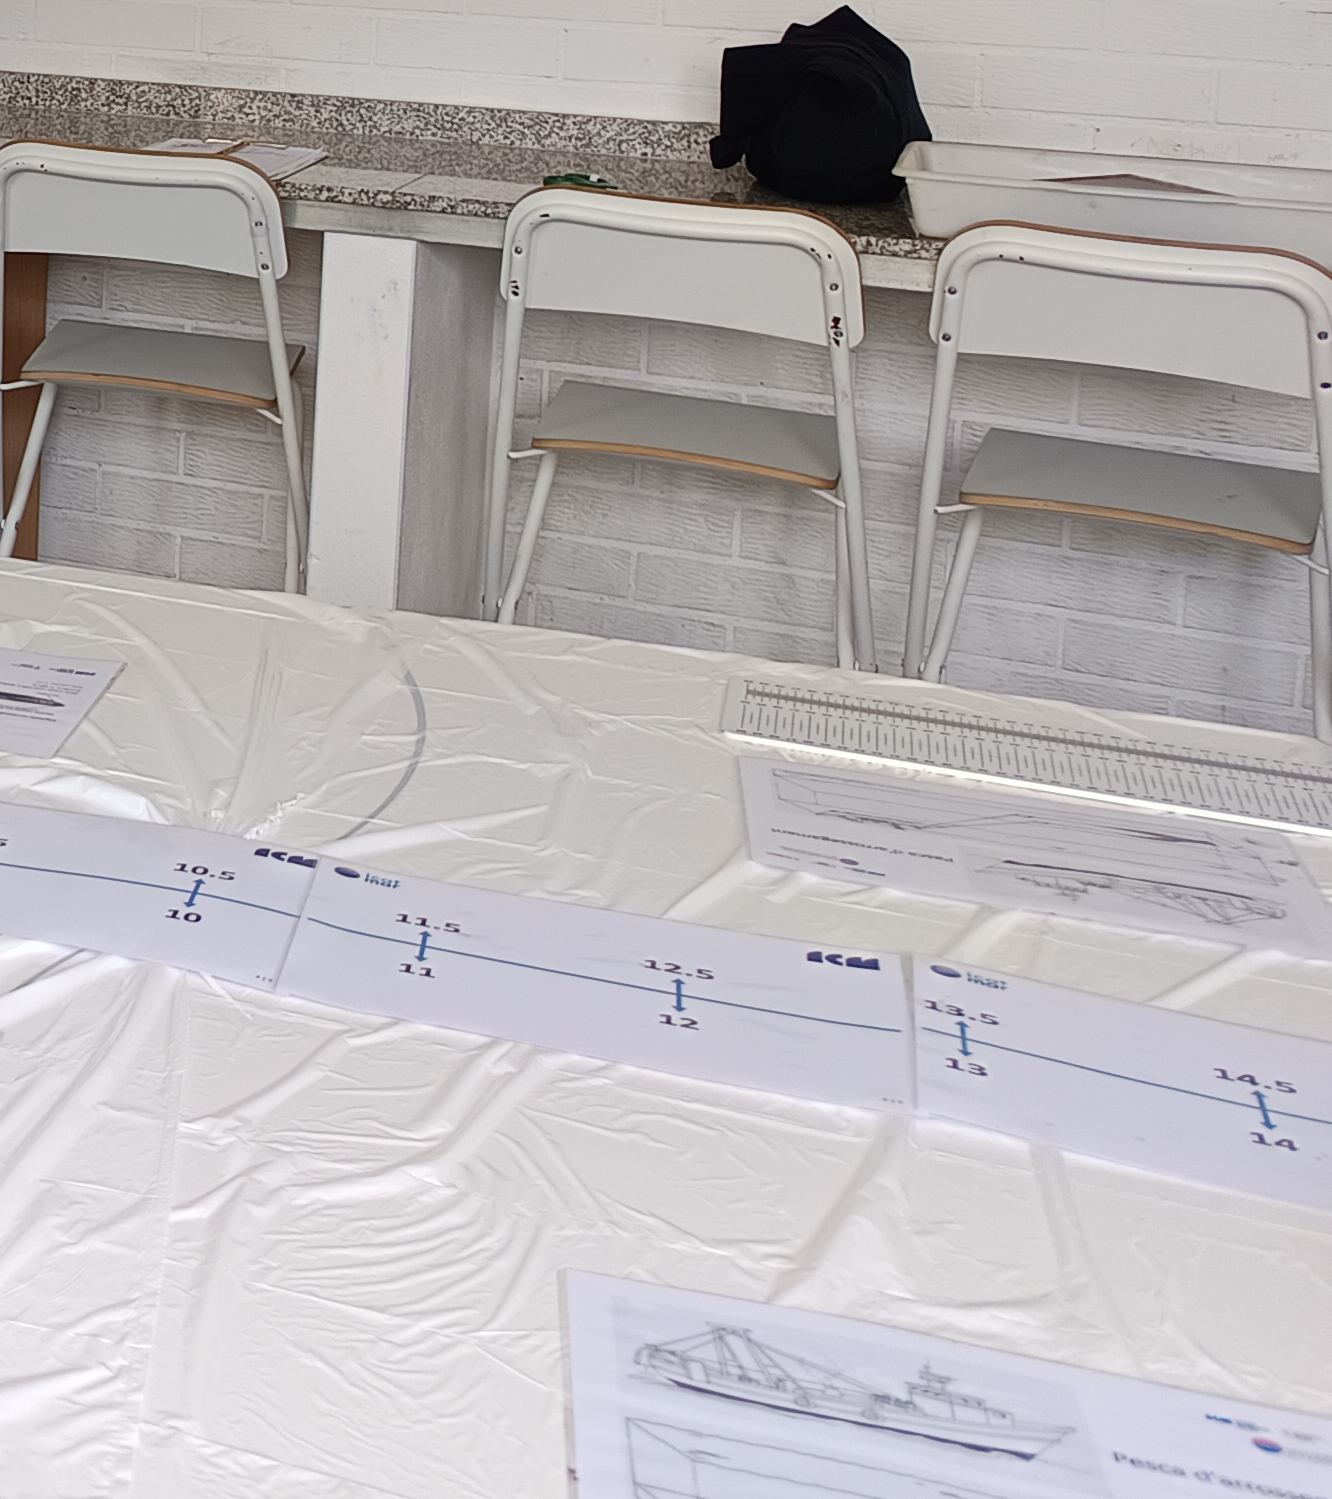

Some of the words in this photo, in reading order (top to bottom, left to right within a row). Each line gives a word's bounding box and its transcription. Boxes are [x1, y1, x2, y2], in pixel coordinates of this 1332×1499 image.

[172, 861, 237, 882] 10.5
[165, 908, 203, 924] 10
[394, 913, 462, 935] 11.5
[398, 962, 437, 979] 11
[642, 958, 716, 981] 12.5
[658, 1013, 701, 1031] 12
[923, 999, 1000, 1027] 13.5
[944, 1057, 989, 1077] 13
[1212, 1067, 1298, 1095] 14.5
[1248, 1131, 1299, 1153] 14
[1112, 1451, 1187, 1478] Pesca
